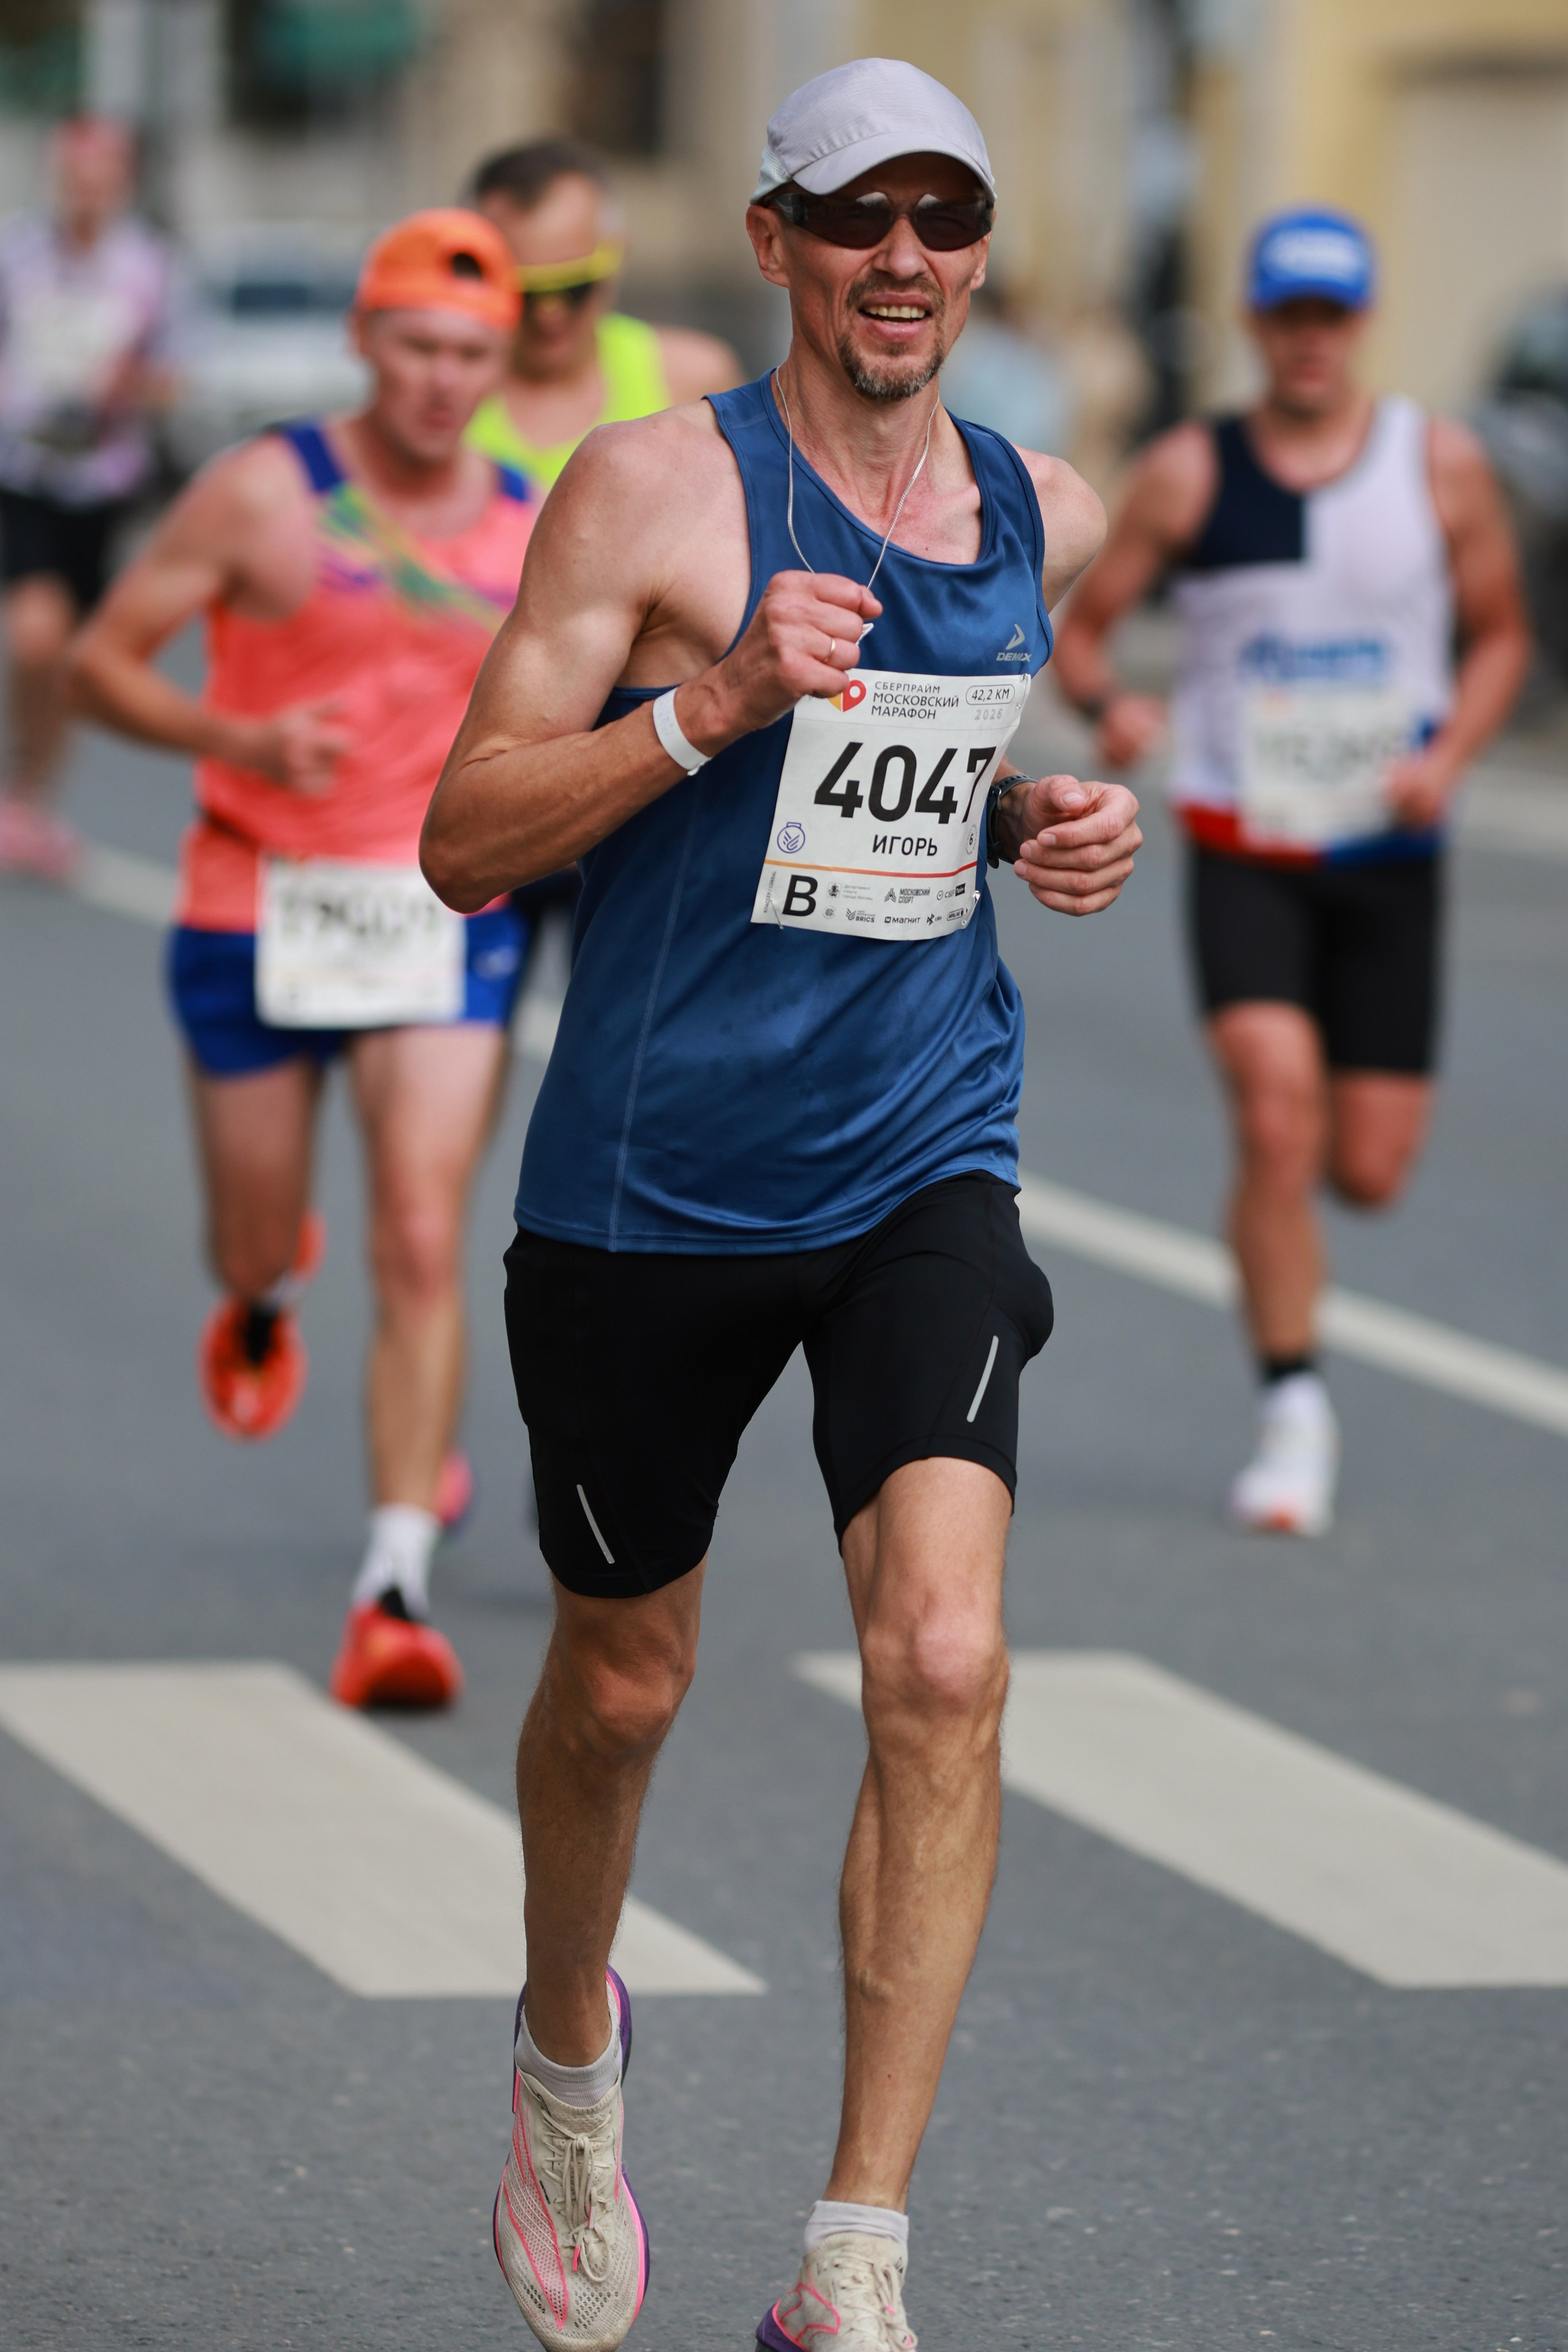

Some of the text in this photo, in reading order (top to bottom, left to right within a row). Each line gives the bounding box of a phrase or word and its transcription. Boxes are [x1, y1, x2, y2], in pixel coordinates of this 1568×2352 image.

[996, 652, 1032, 662] DEMIX
[875, 681, 940, 693] СБЕРПРАЙМ
[873, 693, 960, 707] МОСКОВСКИЙ
[972, 688, 1009, 702] 42,2 КМ
[871, 706, 937, 719] МАРАФОН
[813, 741, 997, 824] 4047
[872, 834, 938, 856] ИГОРЬ
[900, 887, 930, 896] МОСКОВСКИЙ
